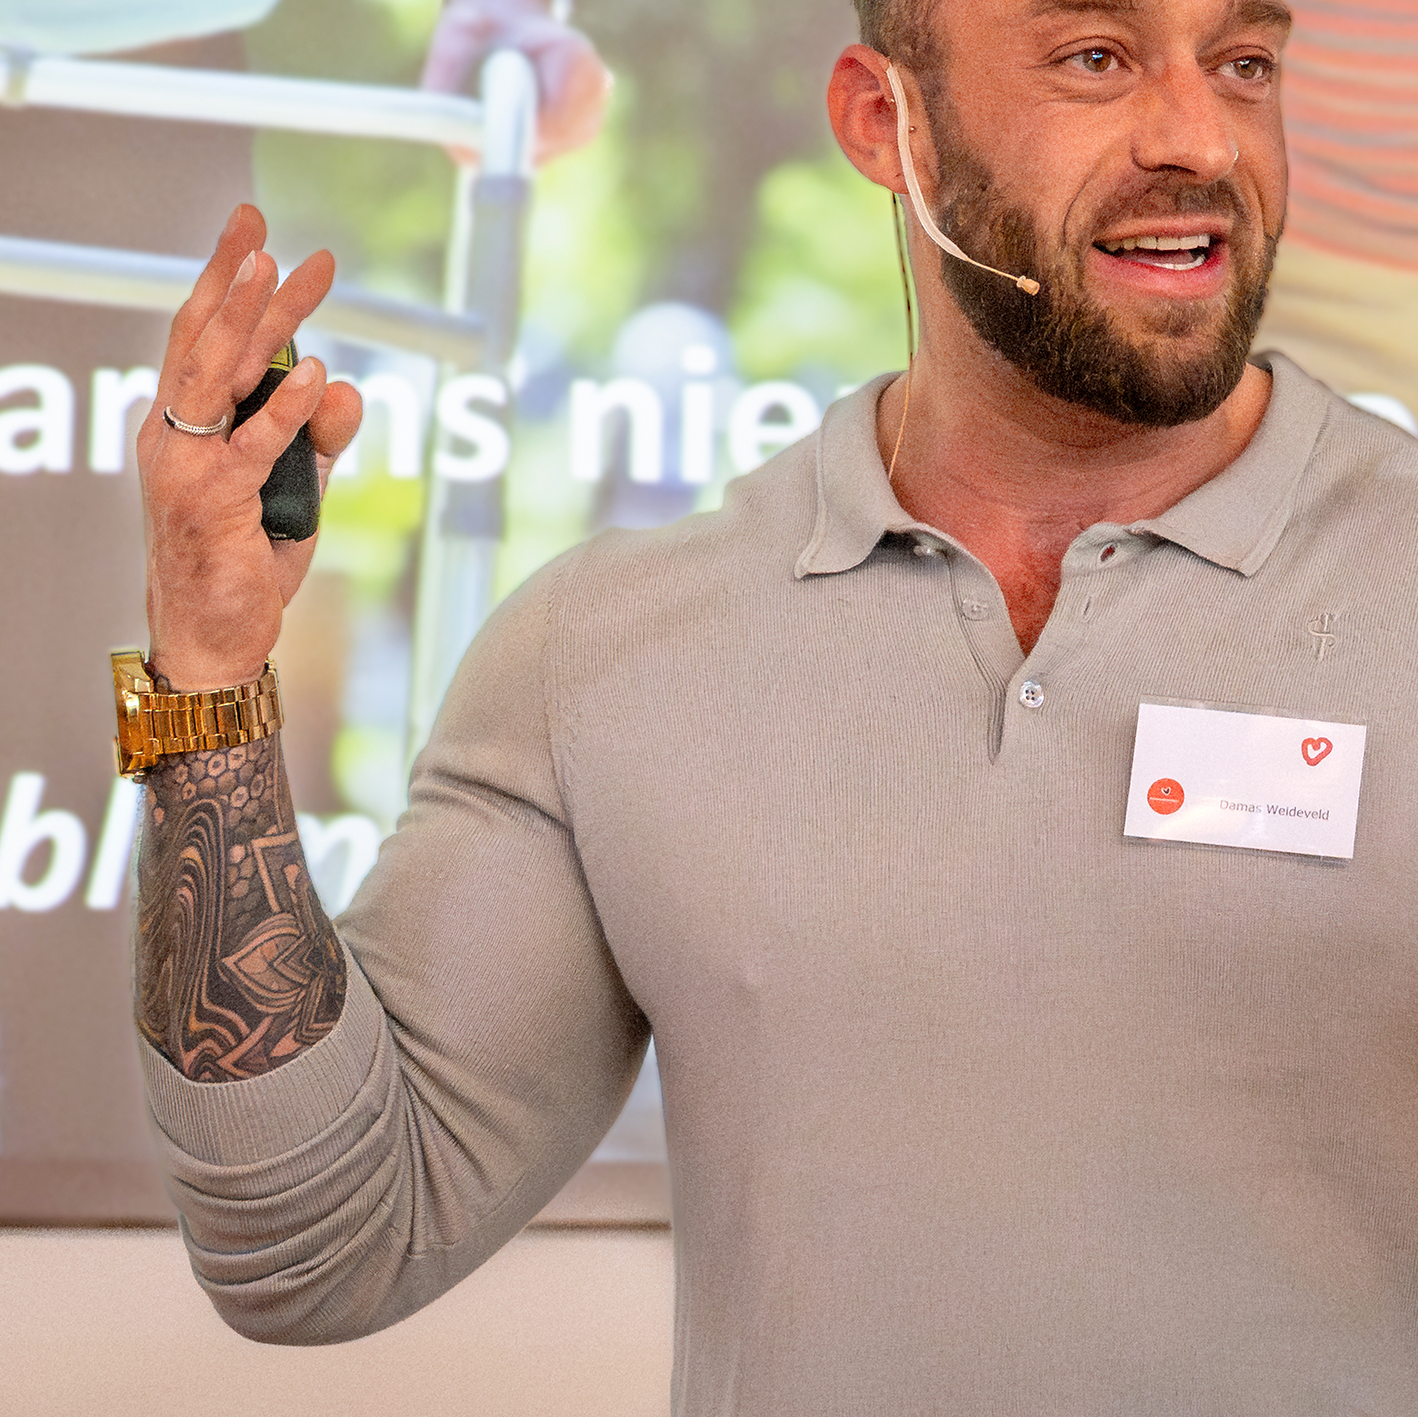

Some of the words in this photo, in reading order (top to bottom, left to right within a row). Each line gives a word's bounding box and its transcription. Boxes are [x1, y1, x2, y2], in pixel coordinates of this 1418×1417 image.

[328, 372, 512, 481] ns
[570, 344, 865, 483] nie
[1219, 799, 1262, 814] Damas
[1266, 804, 1330, 821] Weideveld
